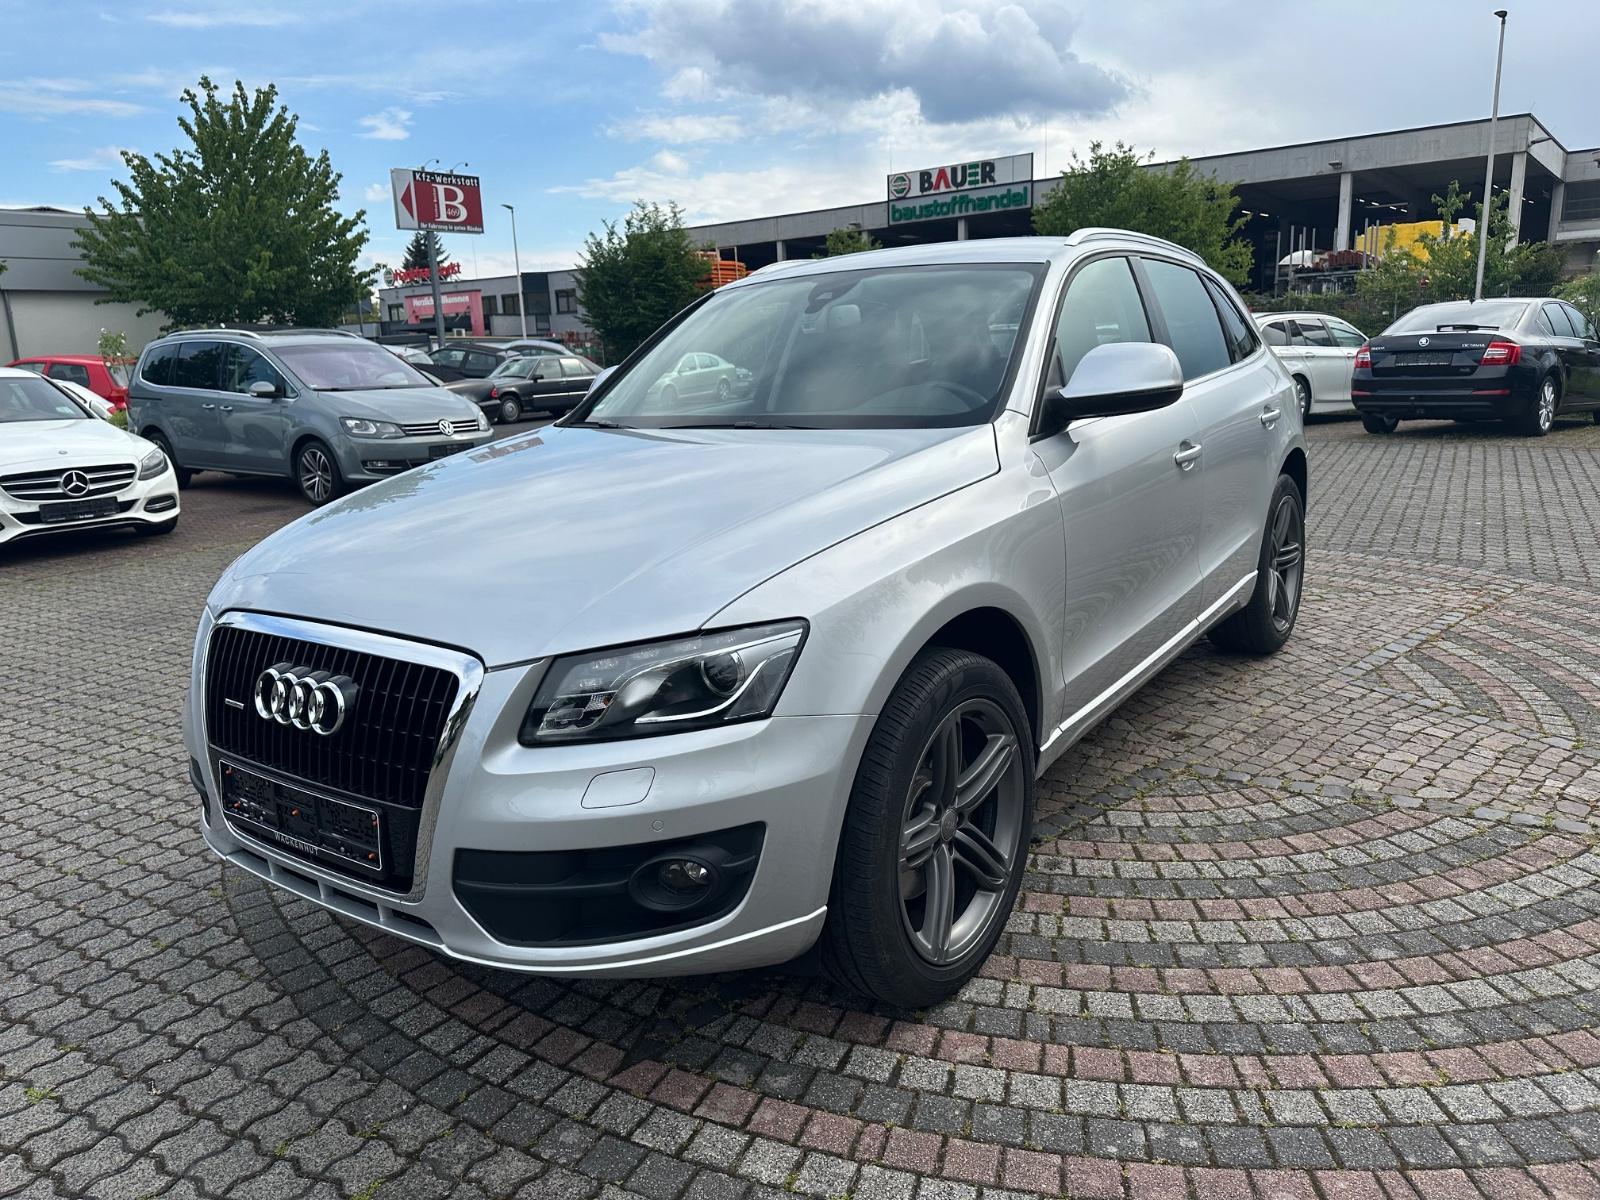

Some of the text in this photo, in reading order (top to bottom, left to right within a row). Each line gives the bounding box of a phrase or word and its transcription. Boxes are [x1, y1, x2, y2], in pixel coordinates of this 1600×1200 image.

[415, 172, 479, 187] Kfz-Werkstatt
[919, 161, 996, 194] BAUER
[431, 183, 468, 223] B
[446, 208, 461, 217] 469
[891, 186, 1028, 222] baustoffhandel
[273, 831, 319, 856] WACKENHUT
